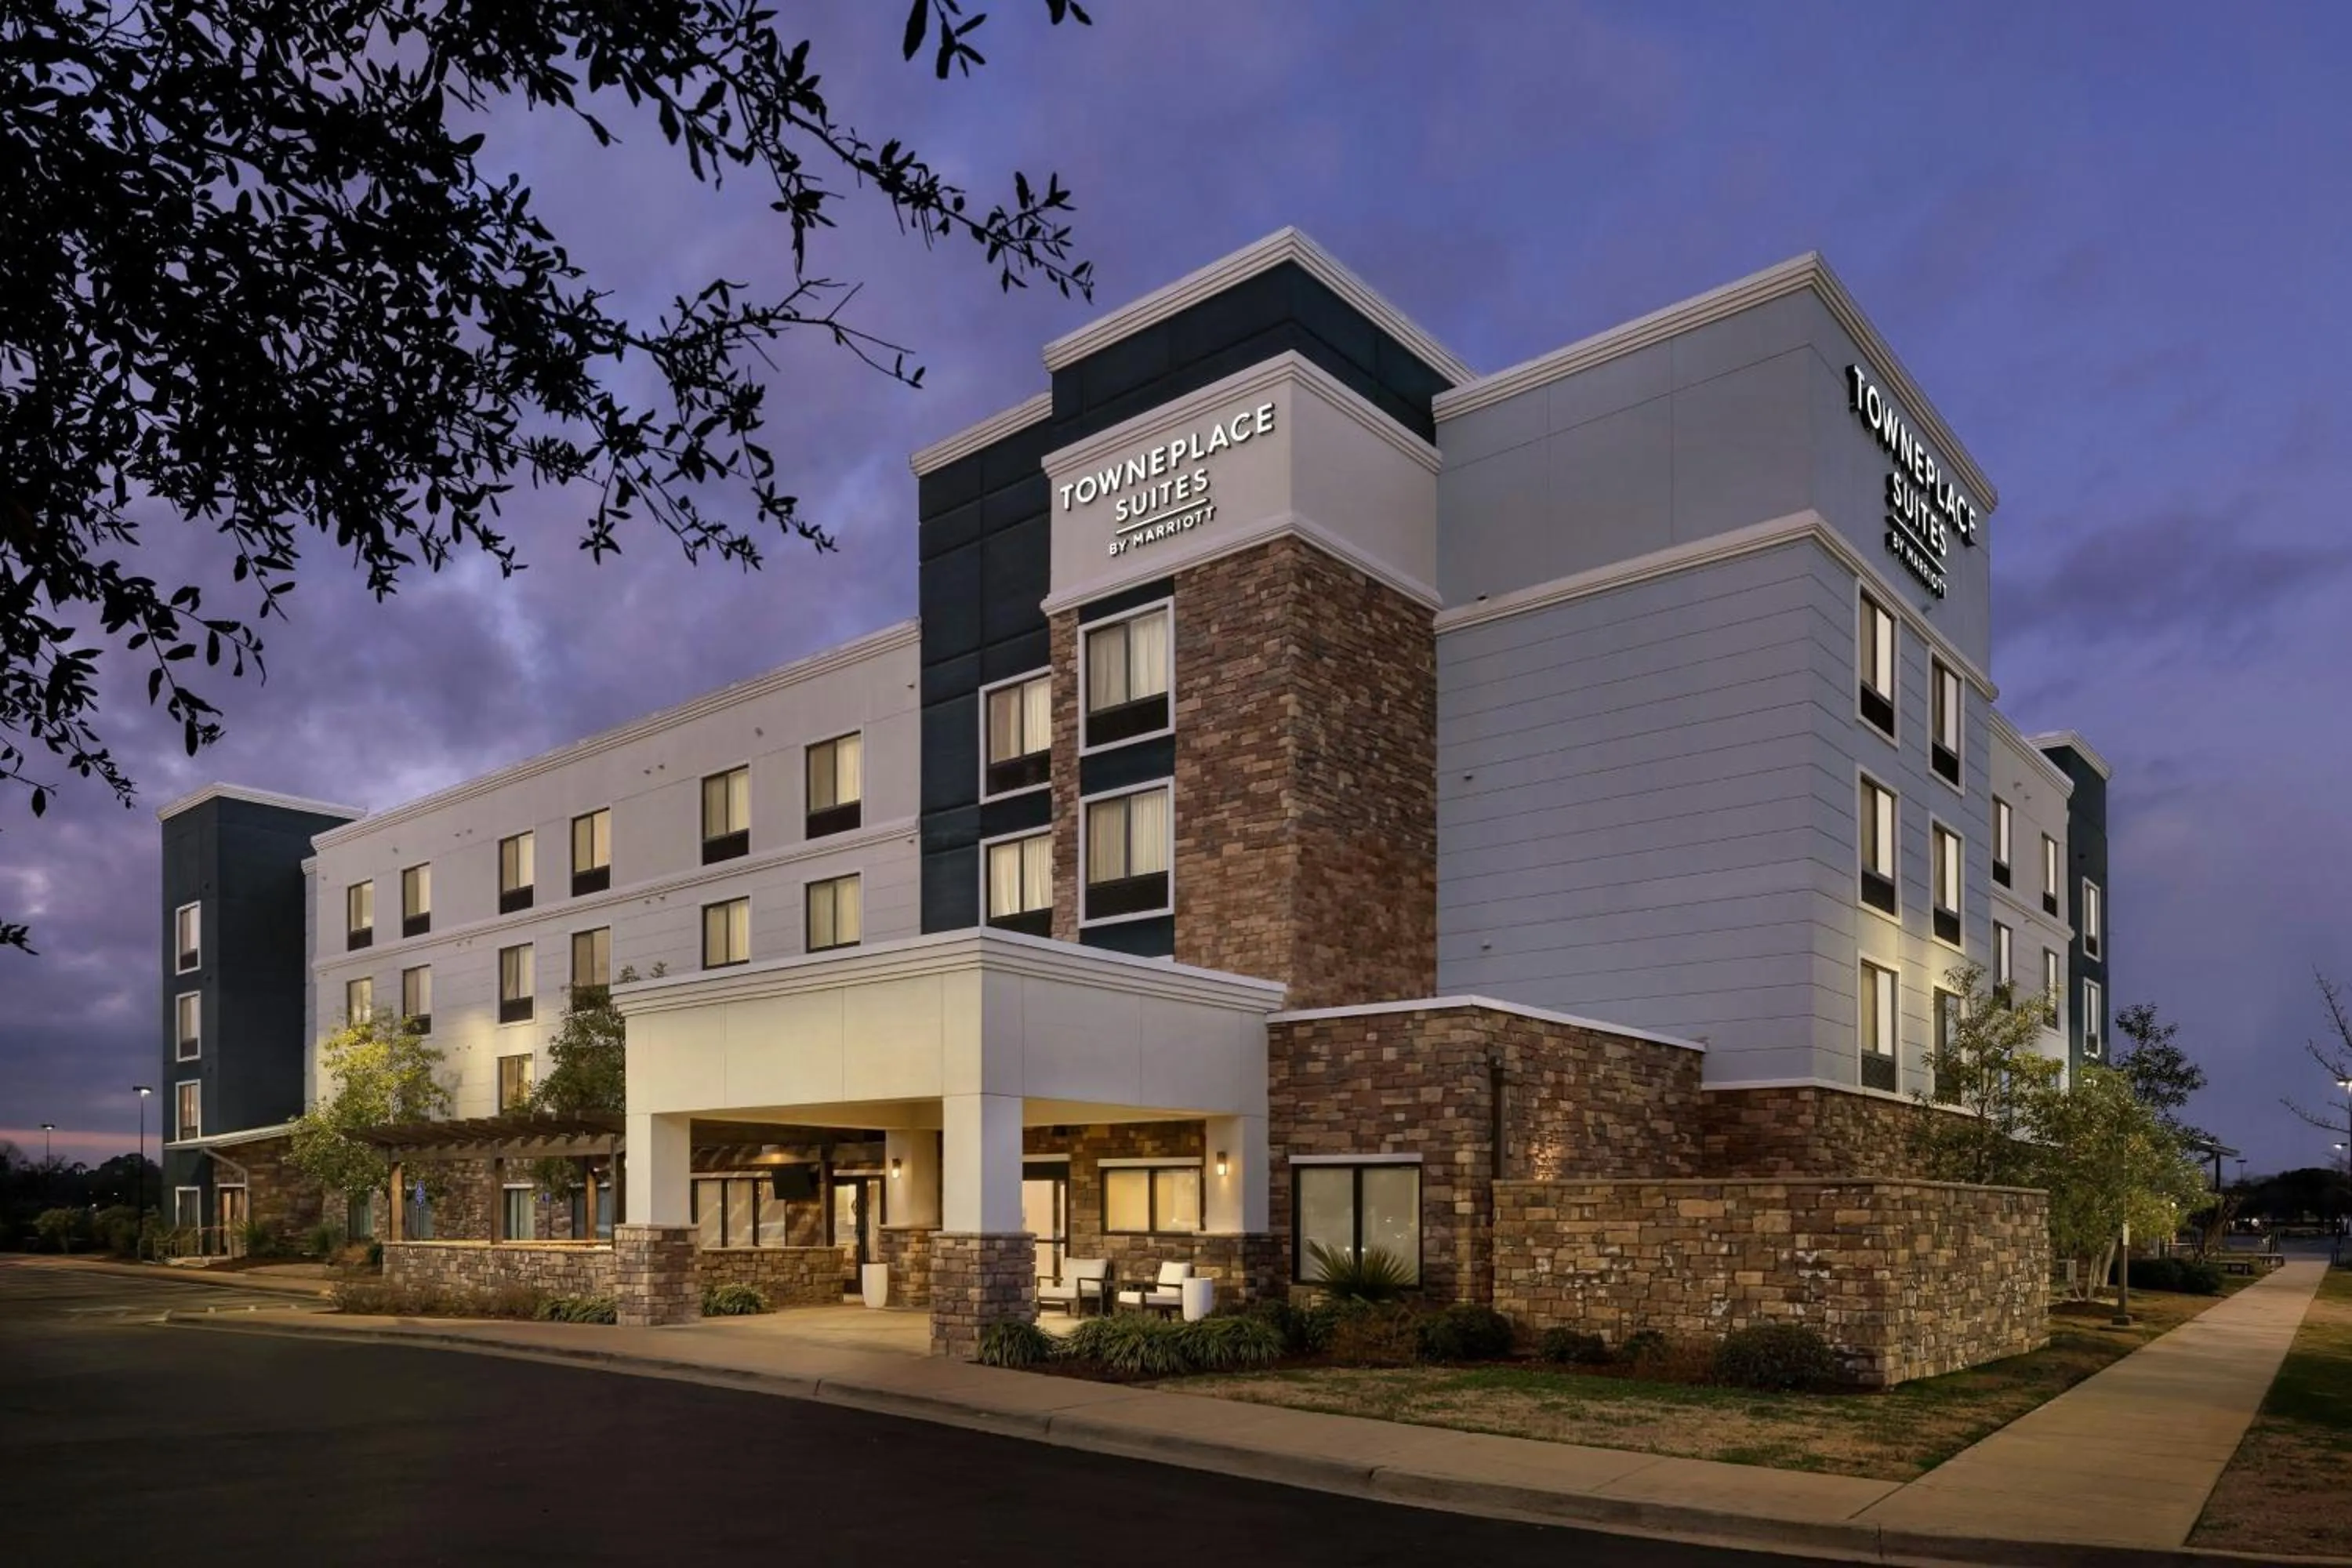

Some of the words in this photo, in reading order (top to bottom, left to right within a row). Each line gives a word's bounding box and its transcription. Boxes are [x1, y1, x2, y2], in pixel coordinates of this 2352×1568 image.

[1059, 401, 1275, 510] TOWNEPLACE
[1115, 468, 1210, 522] SUITES
[1853, 364, 1976, 542] TOWNEPLACE
[1109, 540, 1127, 556] BY
[1133, 506, 1216, 544] MARRIOTT
[1893, 471, 1947, 557] SUITES
